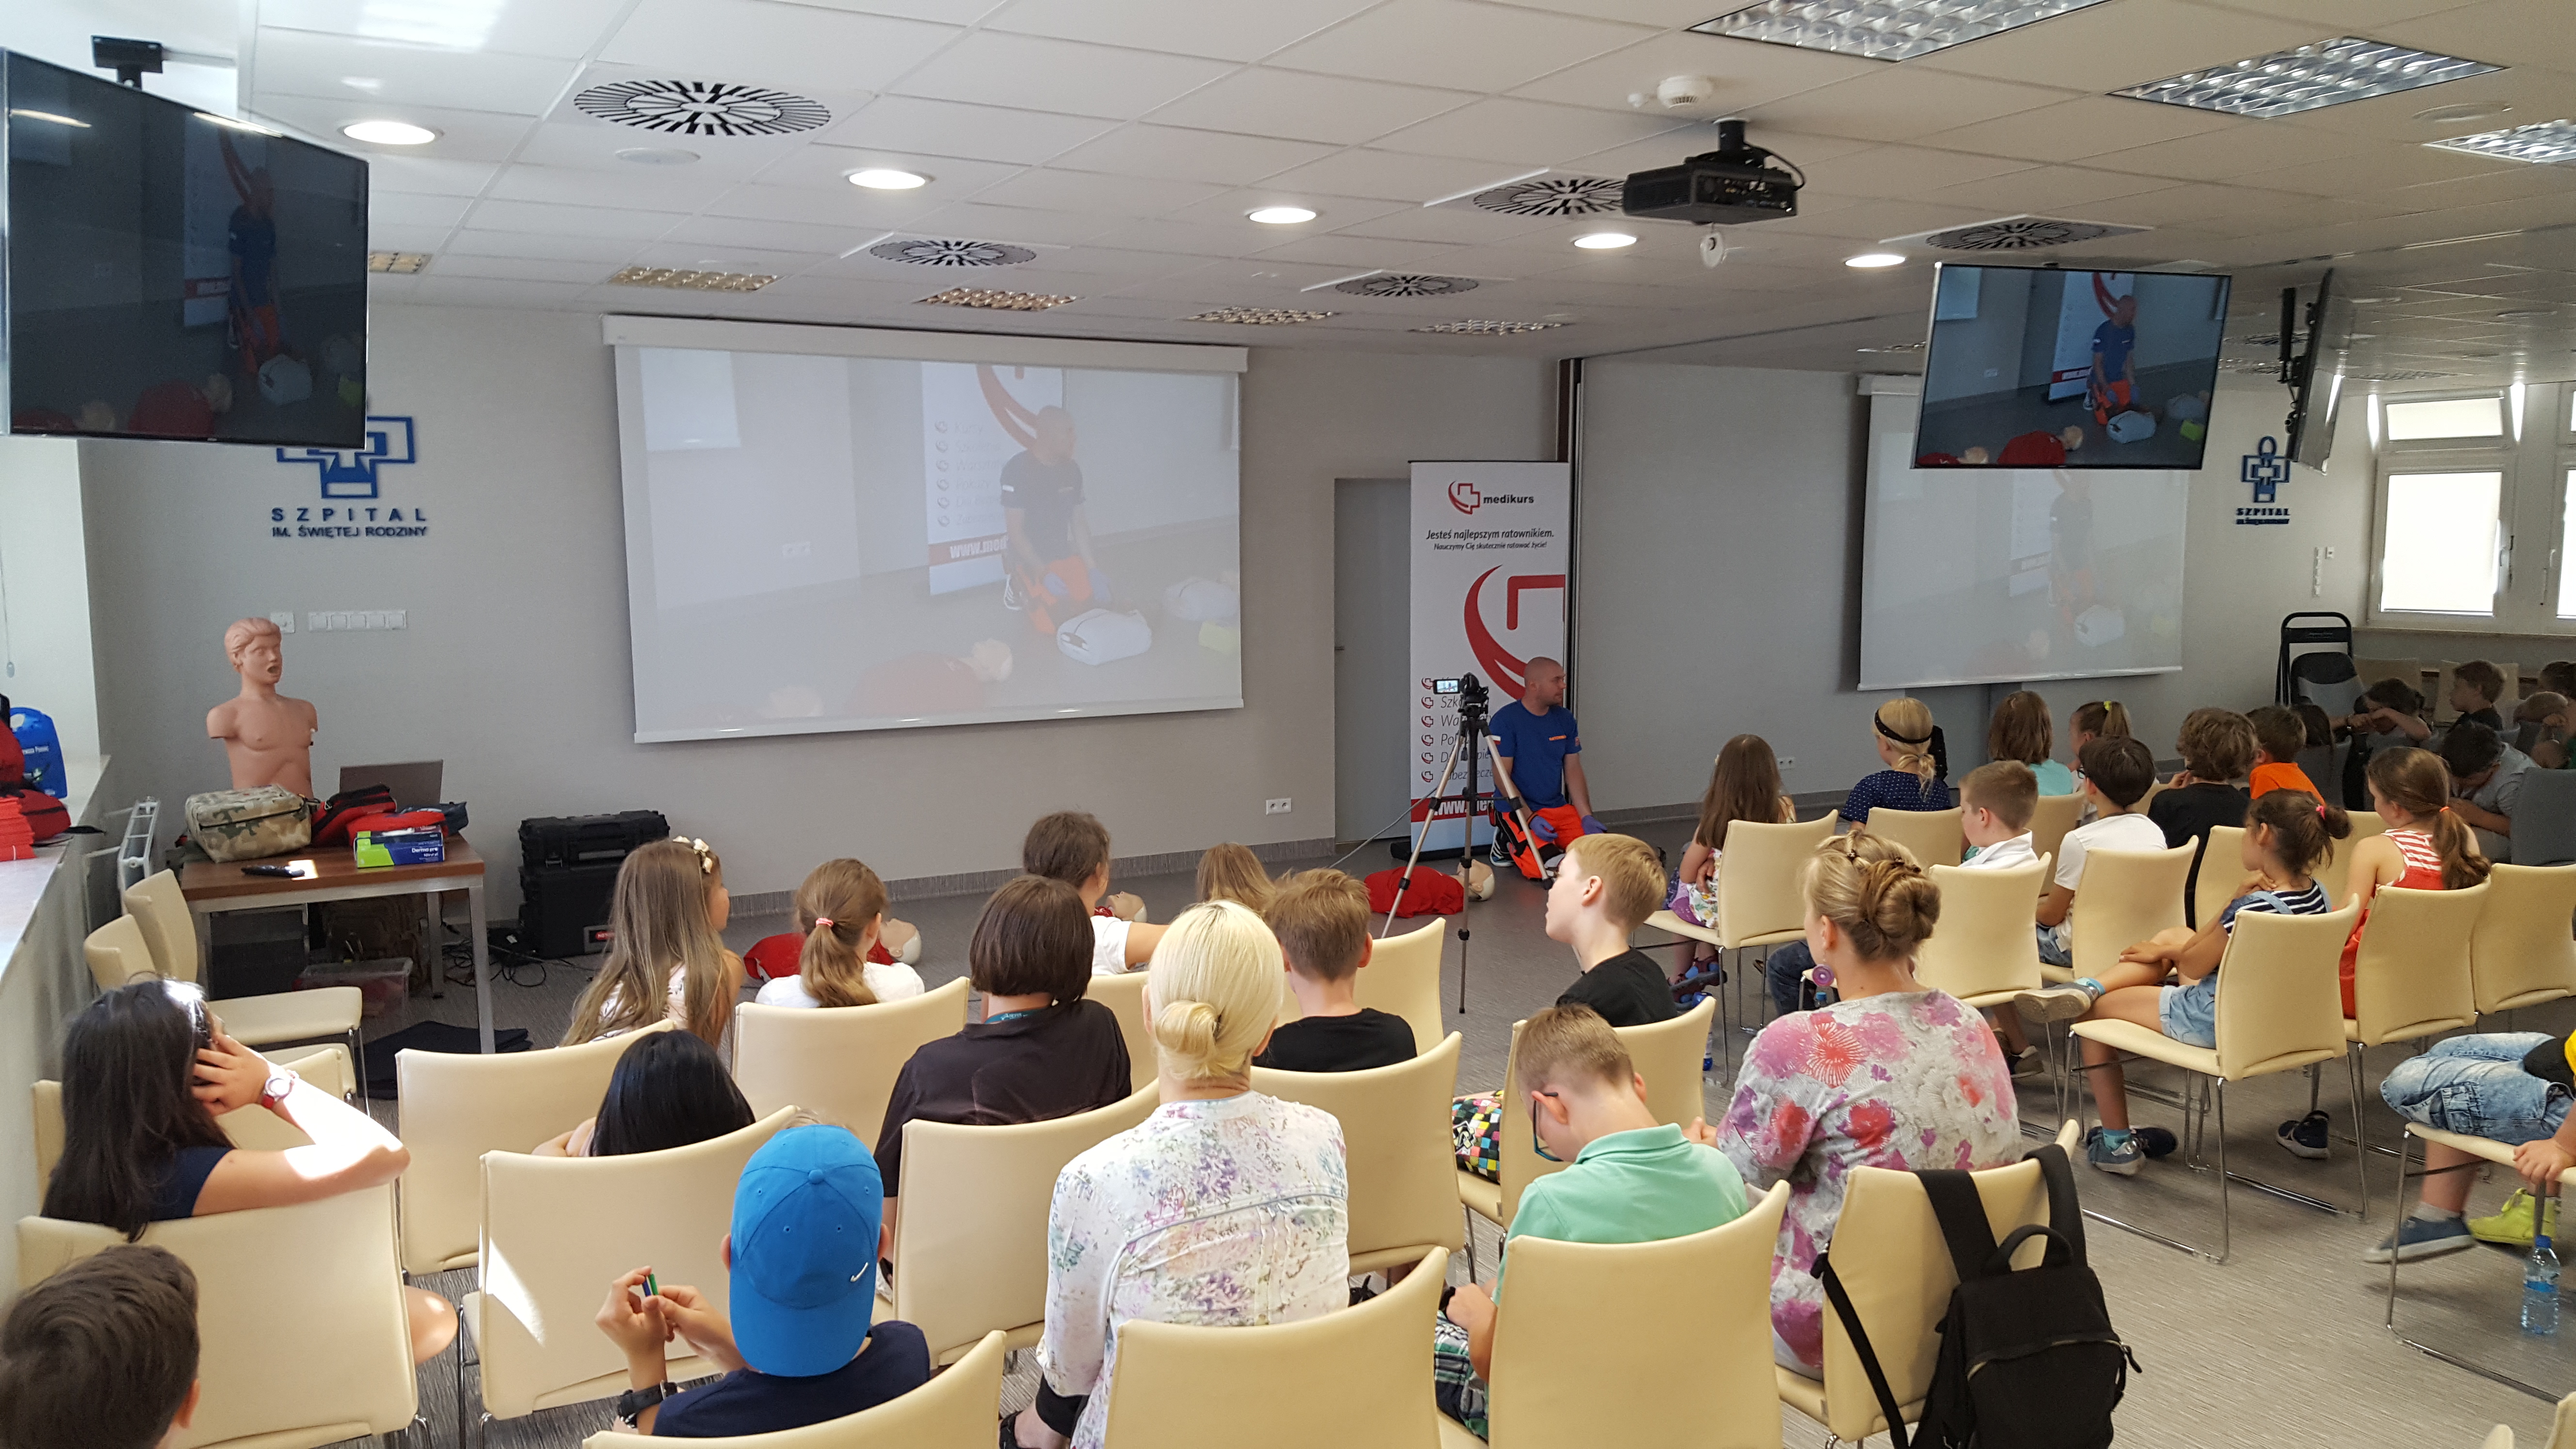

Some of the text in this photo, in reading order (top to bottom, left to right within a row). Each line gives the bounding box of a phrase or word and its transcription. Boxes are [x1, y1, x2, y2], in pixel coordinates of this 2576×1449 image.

[1483, 494, 1534, 504] medikurs
[271, 507, 426, 522] SZPITAL
[2236, 507, 2290, 516] SZPITAL
[272, 525, 427, 539] IM. ŚWIĘTEJ RODZINY
[1426, 528, 1555, 541] Jesteś najlepszym ratownikiem.
[1433, 543, 1464, 551] Nauczymy
